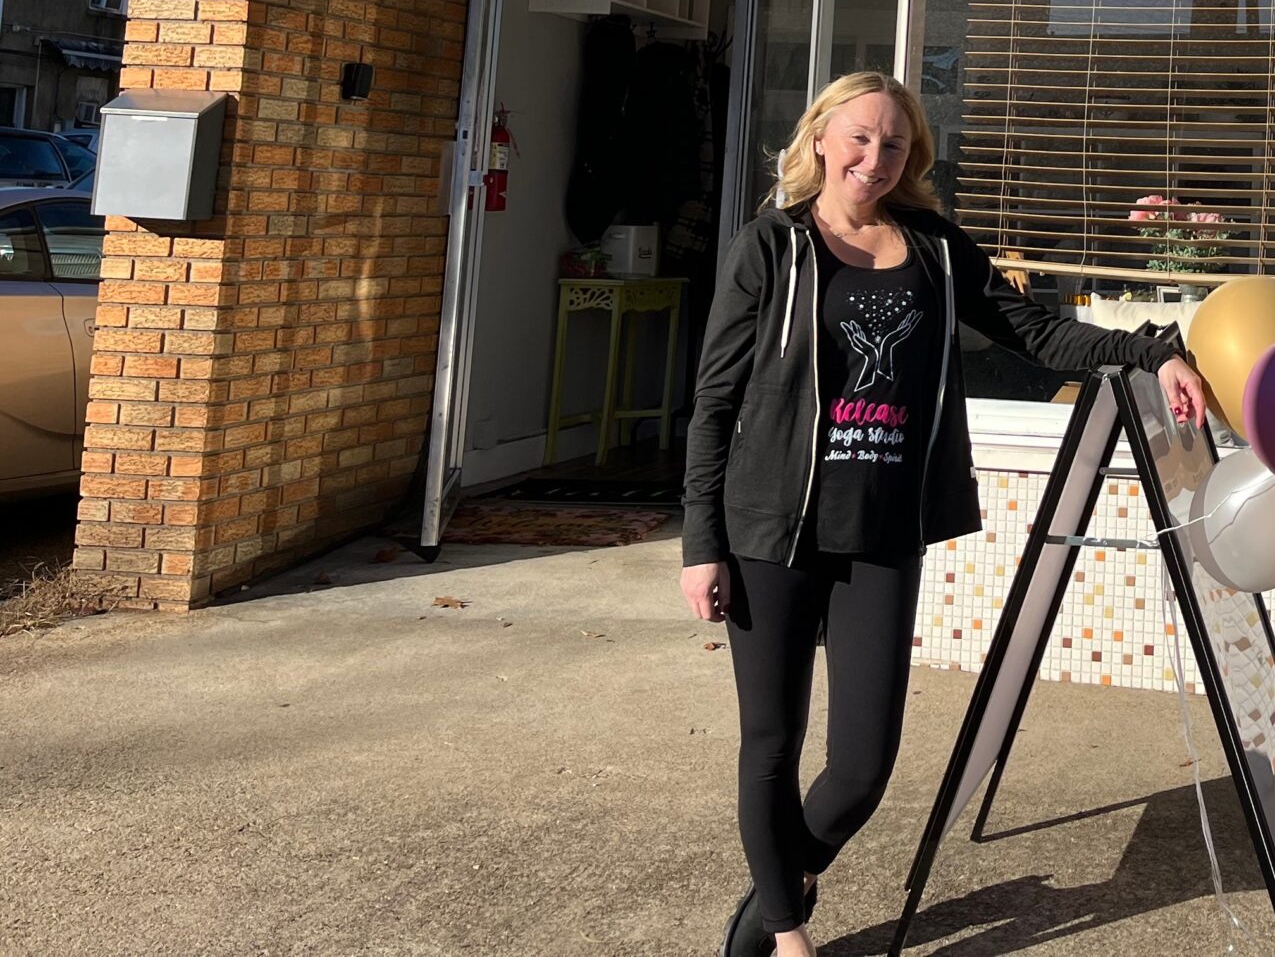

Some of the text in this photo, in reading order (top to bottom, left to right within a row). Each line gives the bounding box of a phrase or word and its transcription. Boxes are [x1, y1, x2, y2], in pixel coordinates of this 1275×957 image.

[830, 398, 909, 426] Release
[828, 427, 864, 446] Yoga
[825, 449, 852, 461] Mind
[857, 449, 878, 462] Body
